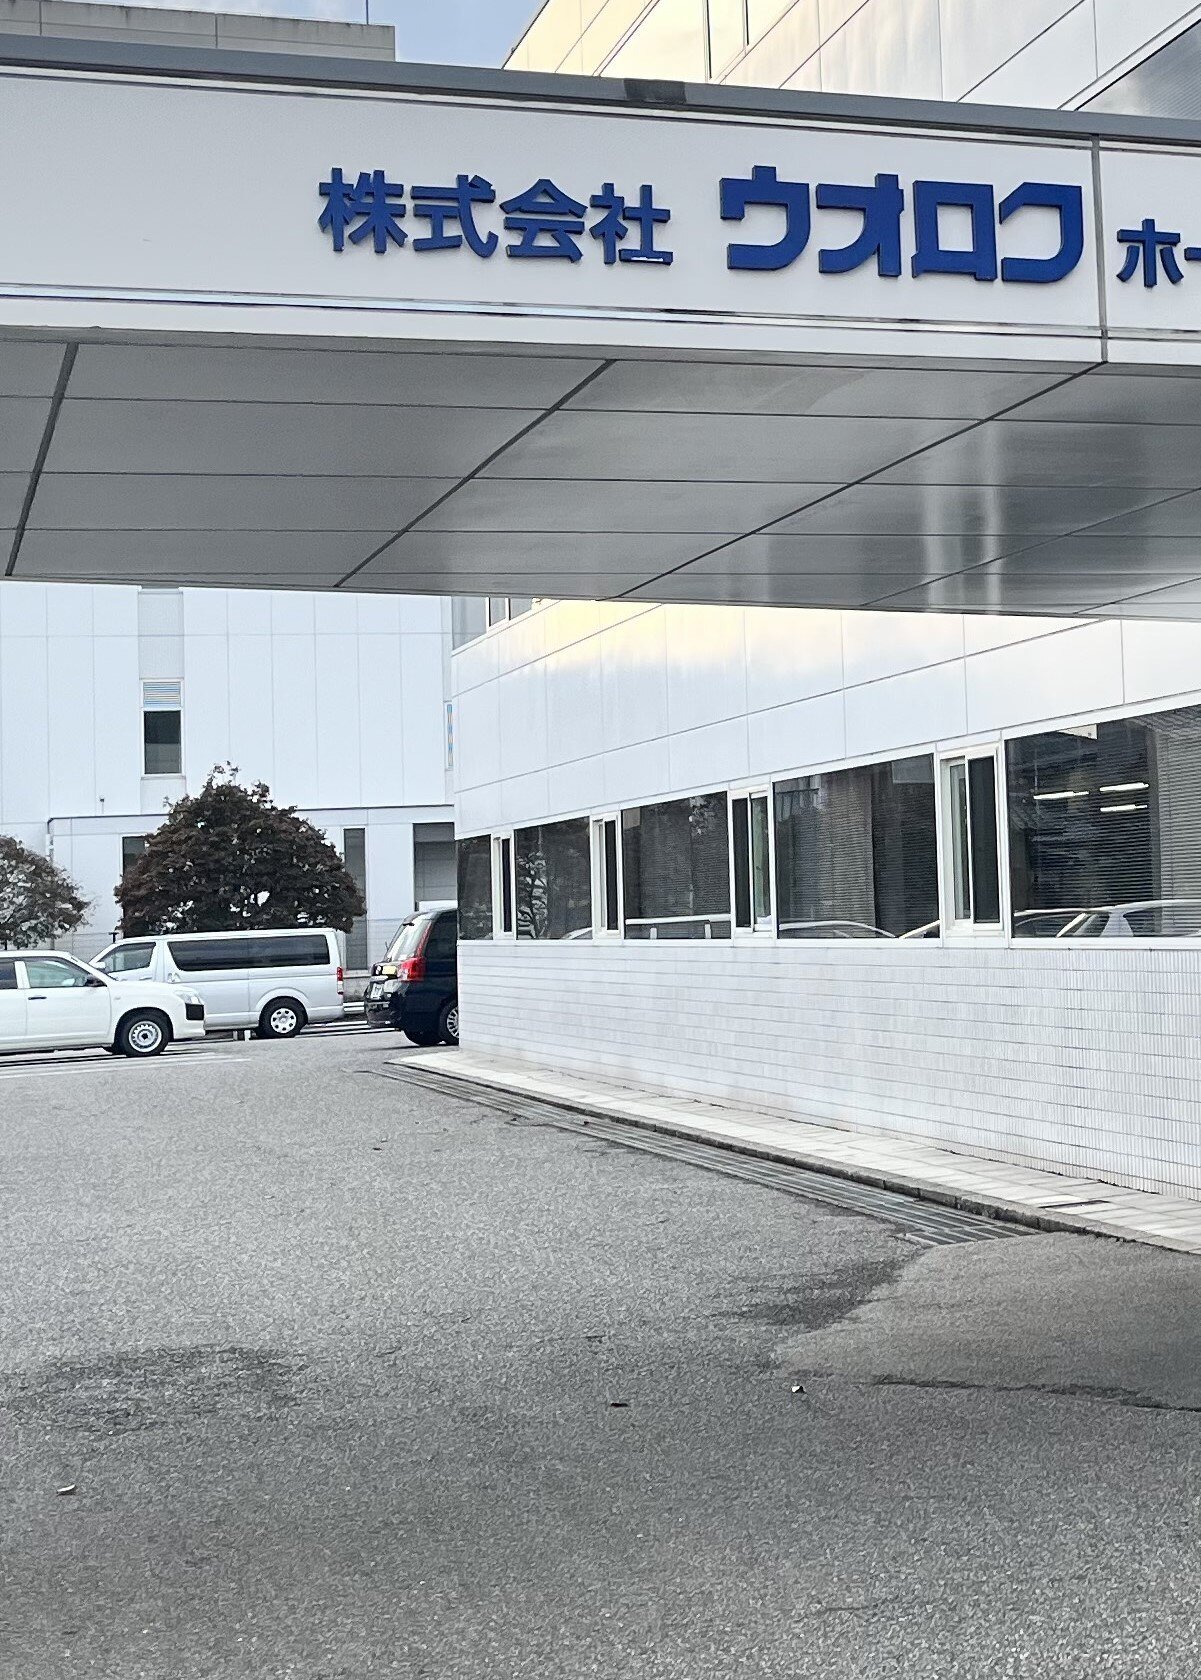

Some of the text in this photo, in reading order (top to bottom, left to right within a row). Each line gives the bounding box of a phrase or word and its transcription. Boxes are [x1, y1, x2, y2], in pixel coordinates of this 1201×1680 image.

[317, 167, 674, 265] 株式会社
[719, 165, 1085, 284] ウオロク
